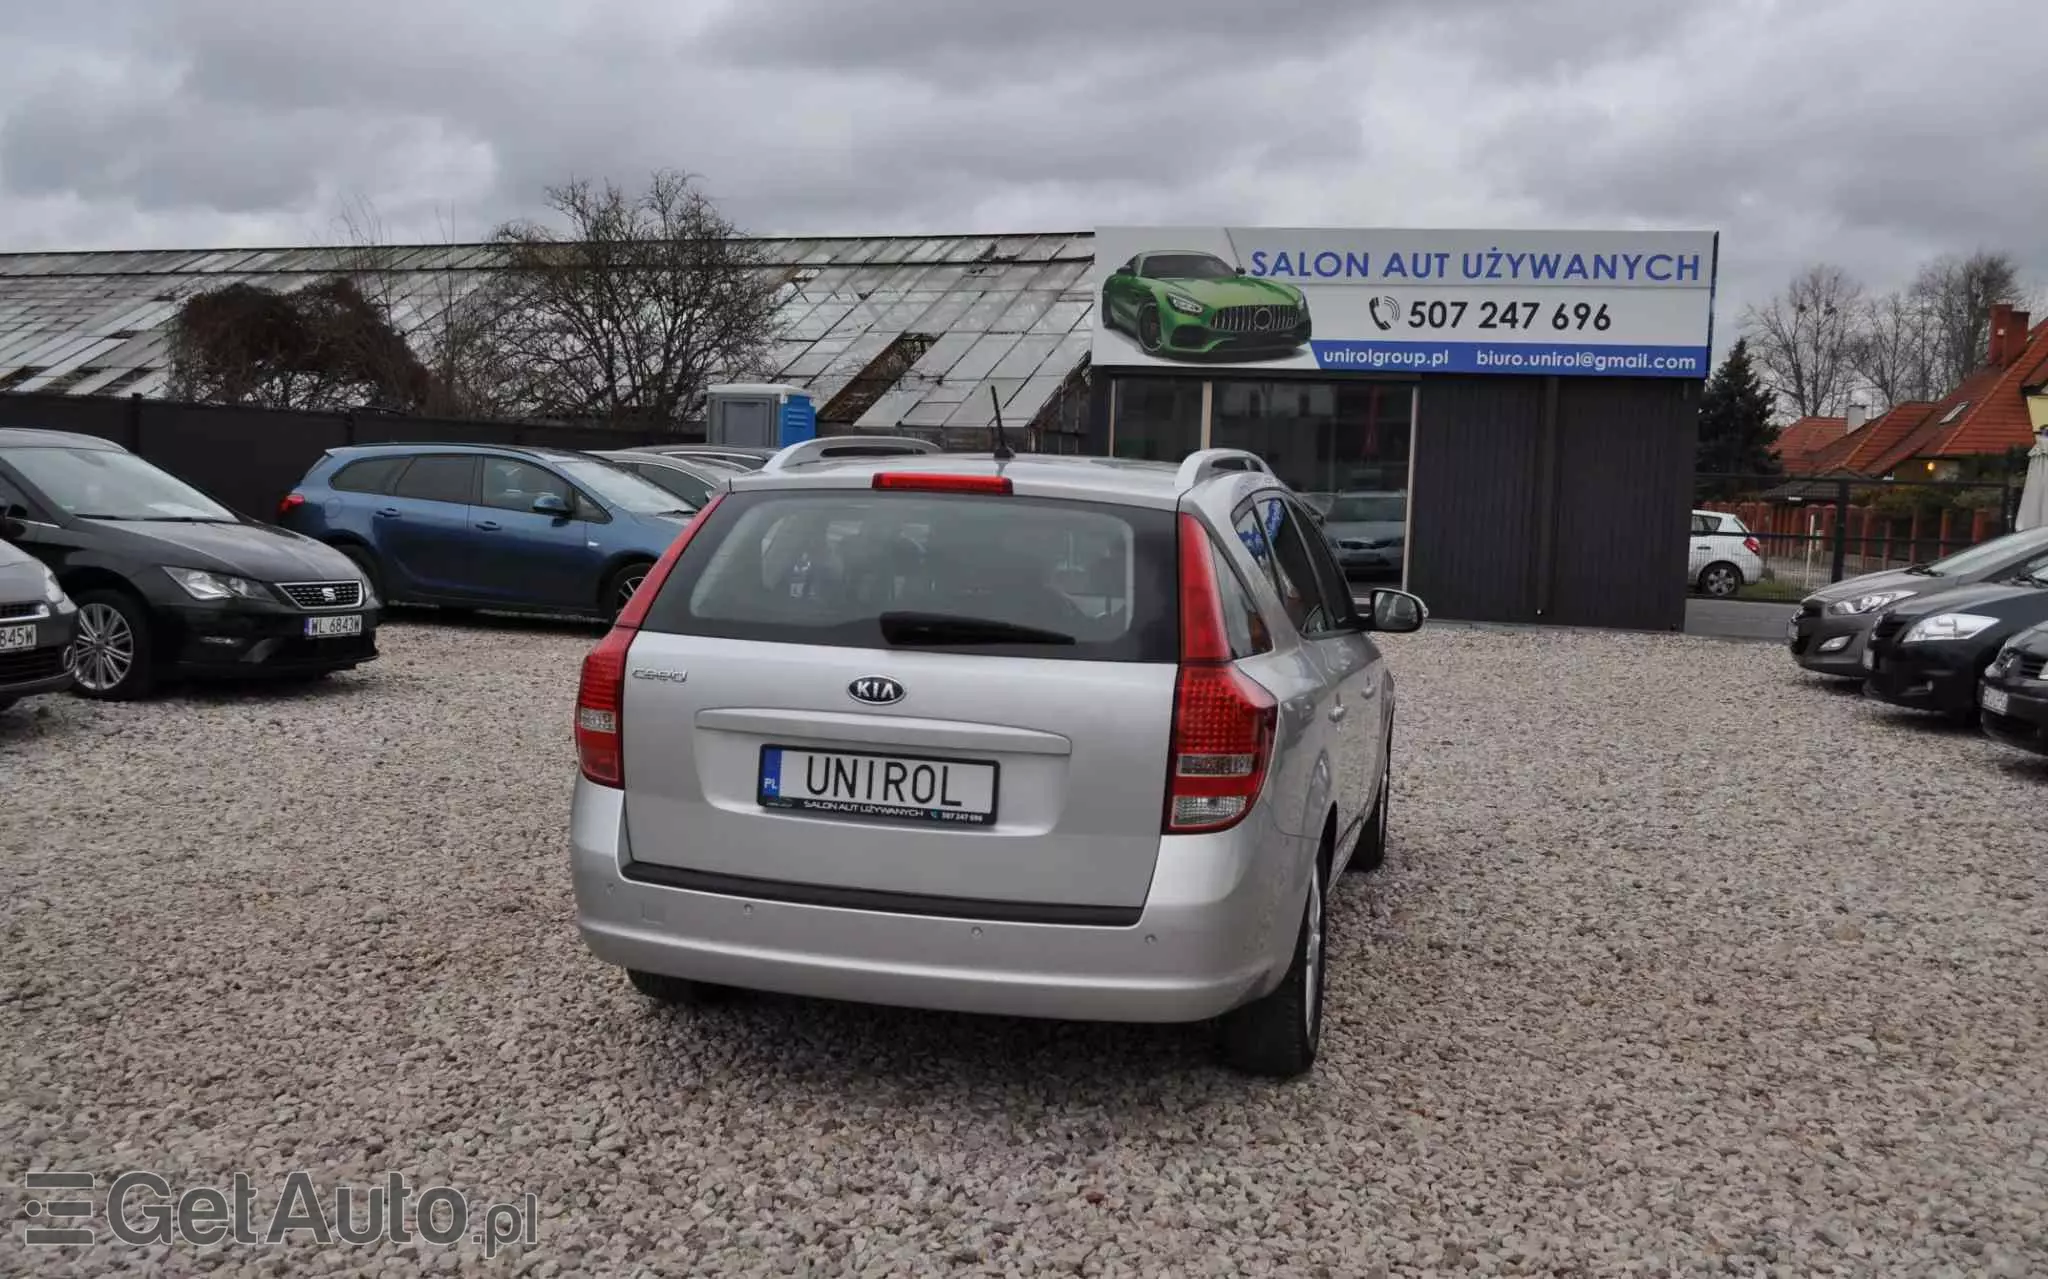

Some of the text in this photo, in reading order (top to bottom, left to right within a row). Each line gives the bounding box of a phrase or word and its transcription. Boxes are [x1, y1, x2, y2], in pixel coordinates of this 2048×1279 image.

[1251, 246, 1699, 281] SALON AUT UŻYWANYCH
[1408, 301, 1612, 331] 507 247 696
[1323, 348, 1449, 367] unirolgroup.pl
[1476, 350, 1697, 371] biuro.unirol@gmail.com
[857, 681, 896, 699] KIA
[764, 778, 778, 790] PL
[807, 755, 962, 807] UNIROL
